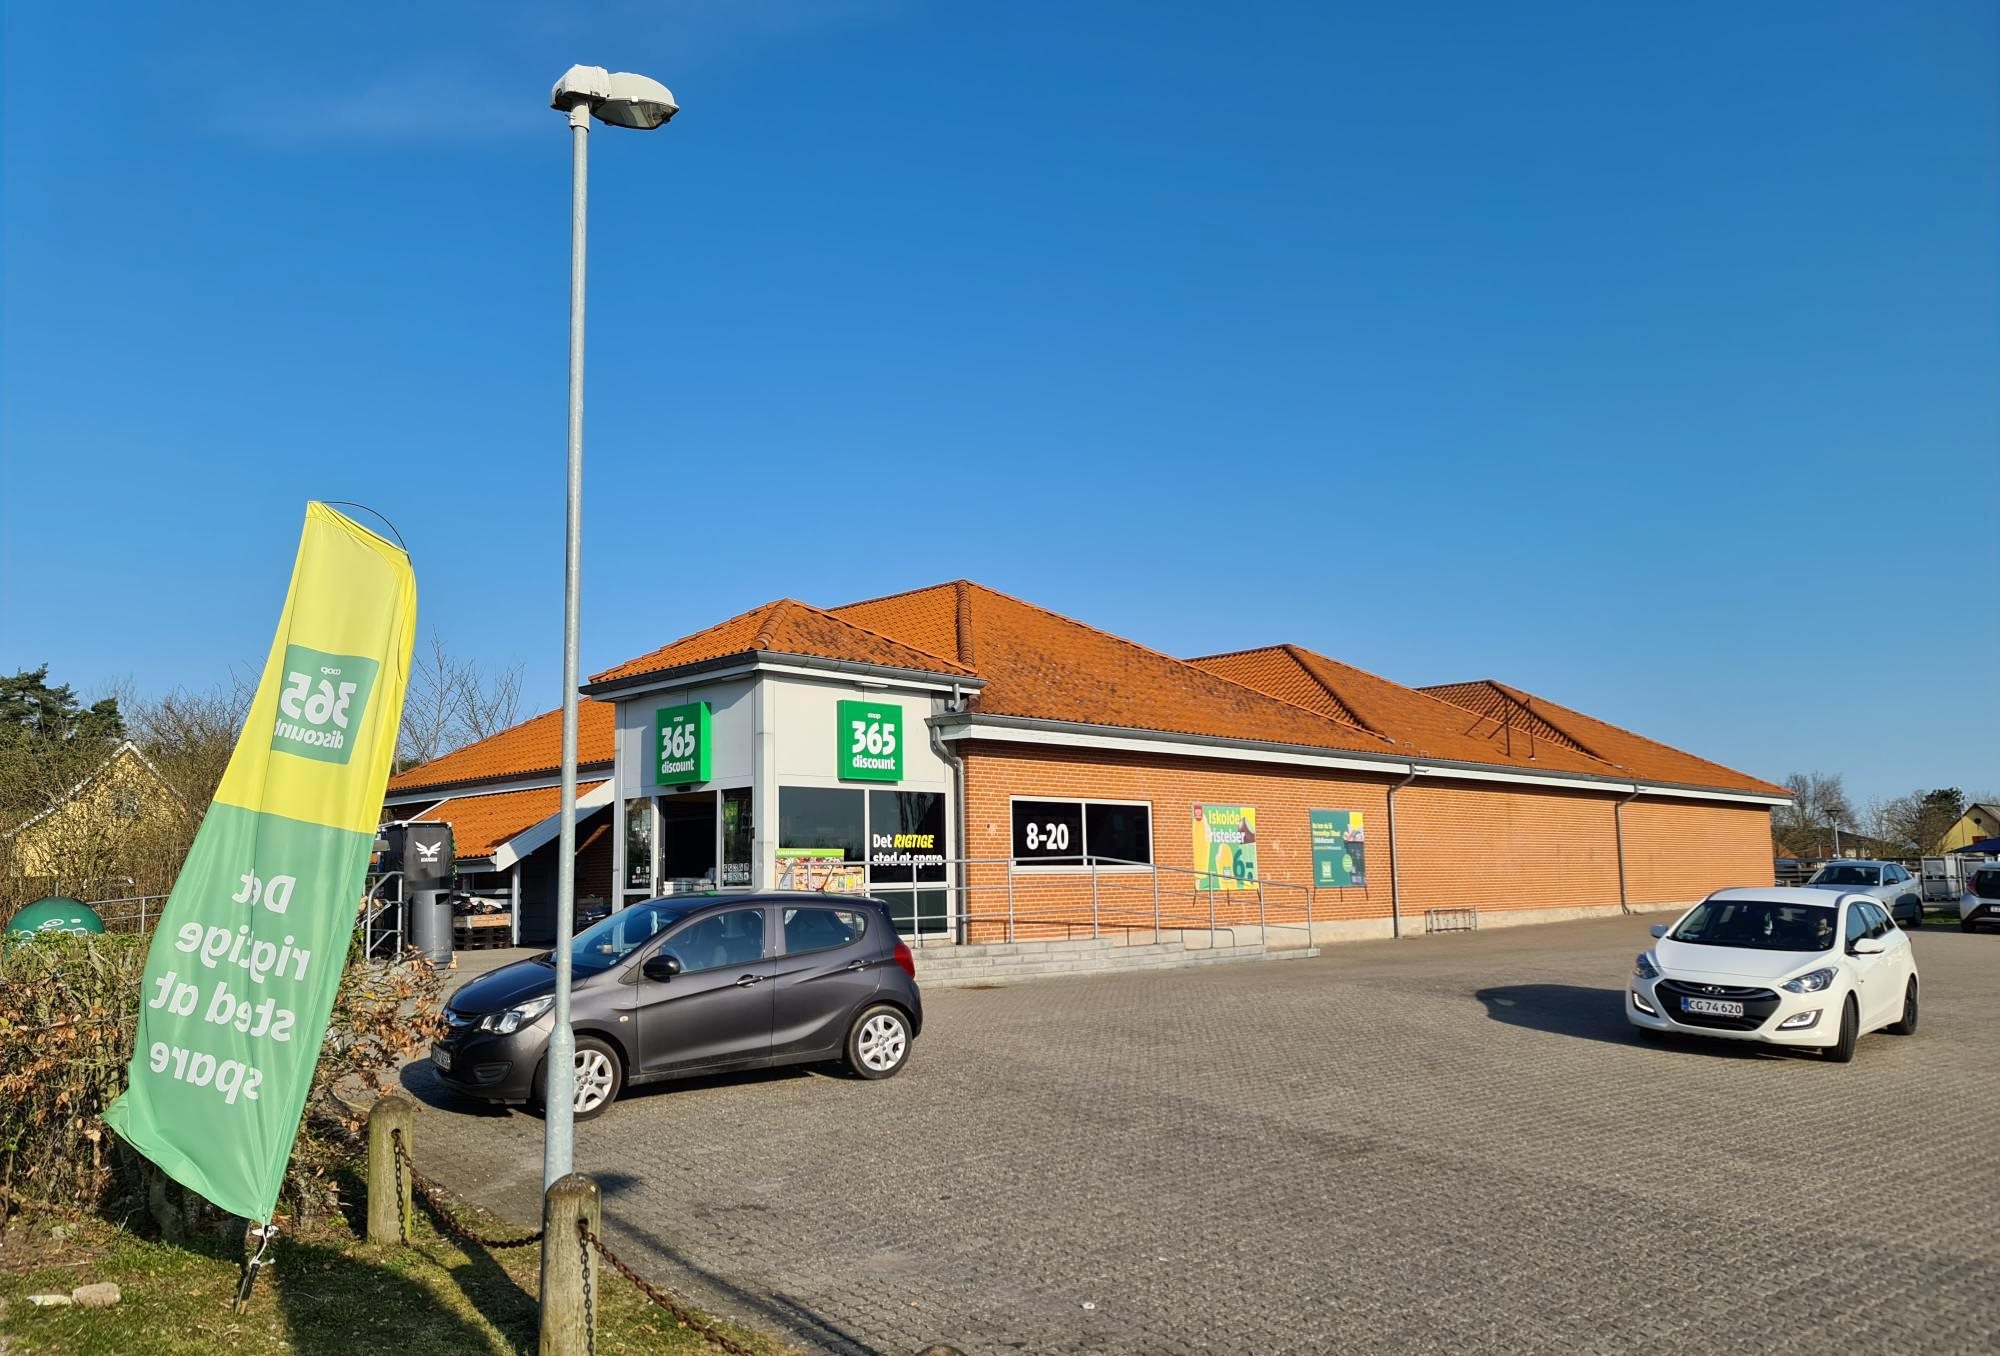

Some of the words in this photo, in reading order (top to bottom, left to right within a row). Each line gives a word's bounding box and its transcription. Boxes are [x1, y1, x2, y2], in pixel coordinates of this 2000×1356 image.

[661, 723, 695, 760] 365
[852, 720, 896, 755] 365
[661, 757, 695, 774] discount
[852, 755, 896, 770] discount
[1208, 809, 1240, 825] Iskolde
[873, 834, 893, 848] Det
[893, 834, 935, 849] RIGTIGE
[1026, 822, 1069, 850] 8-20
[873, 852, 898, 866] sted
[899, 852, 912, 866] at
[912, 854, 943, 869] spare
[1705, 1001, 1719, 1012] 74
[1721, 1003, 1742, 1014] 620
